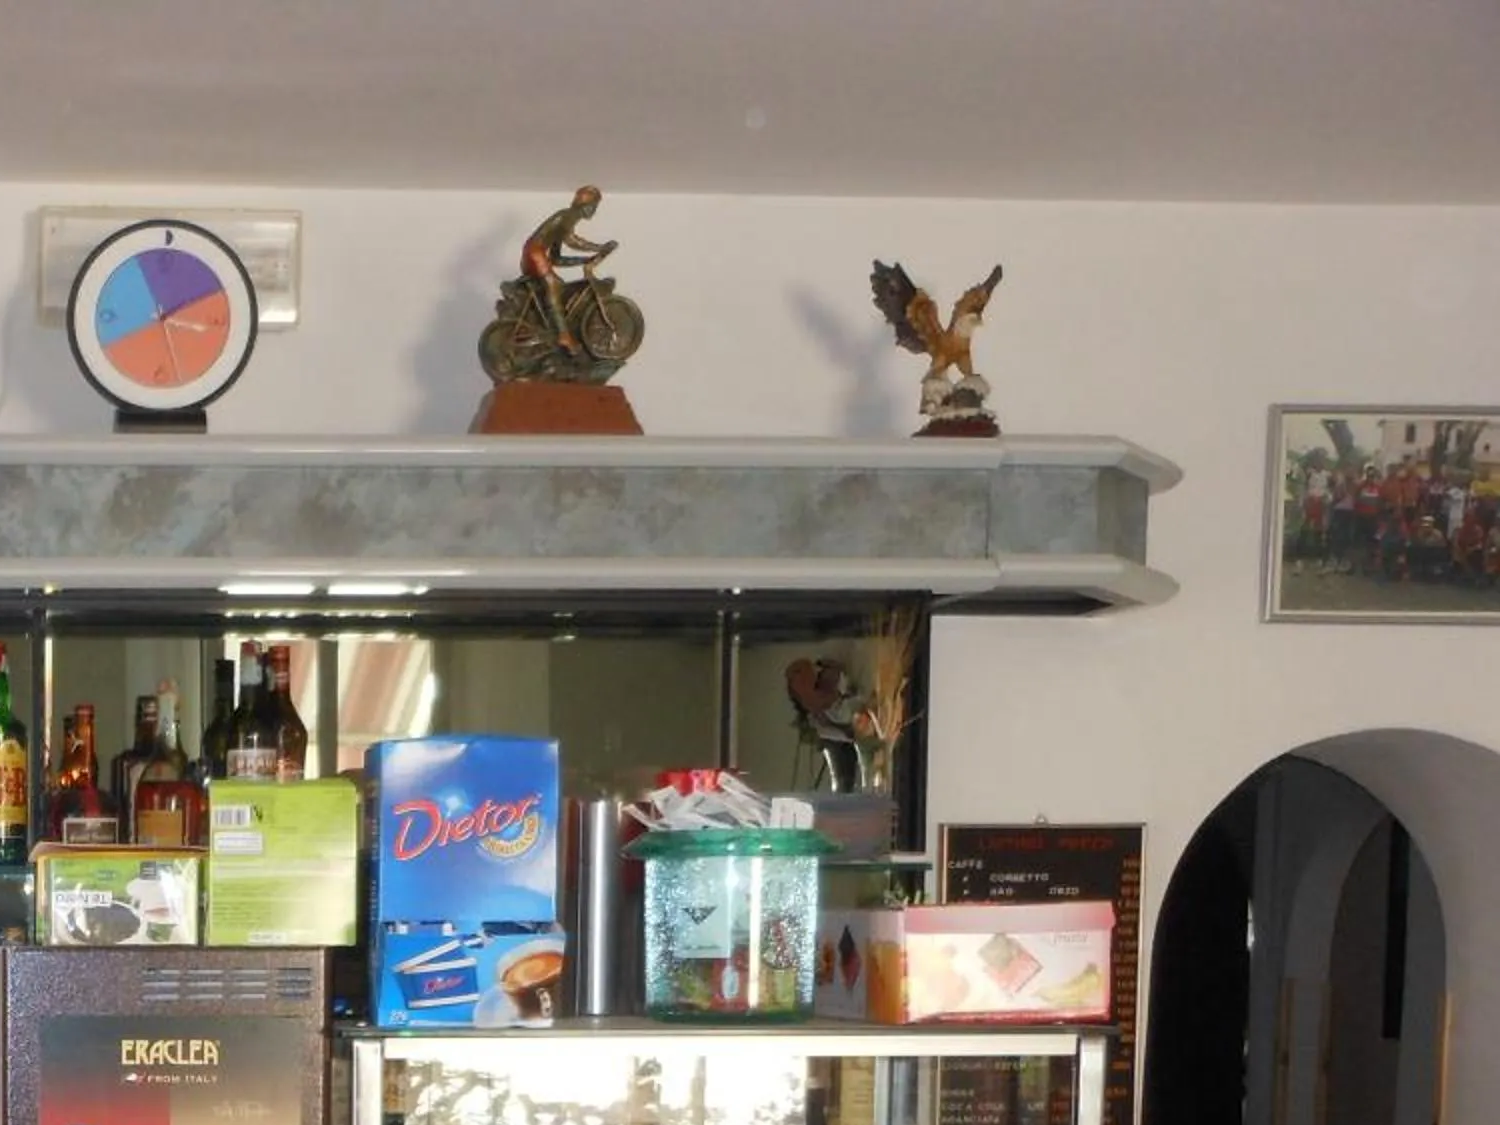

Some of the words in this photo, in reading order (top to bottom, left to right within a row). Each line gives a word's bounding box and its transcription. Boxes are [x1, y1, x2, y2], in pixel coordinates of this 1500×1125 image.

[392, 793, 543, 861] Dietor
[120, 1039, 220, 1066] ERACLEA
[147, 1075, 181, 1084] FROM
[185, 1075, 219, 1084] ITALY
